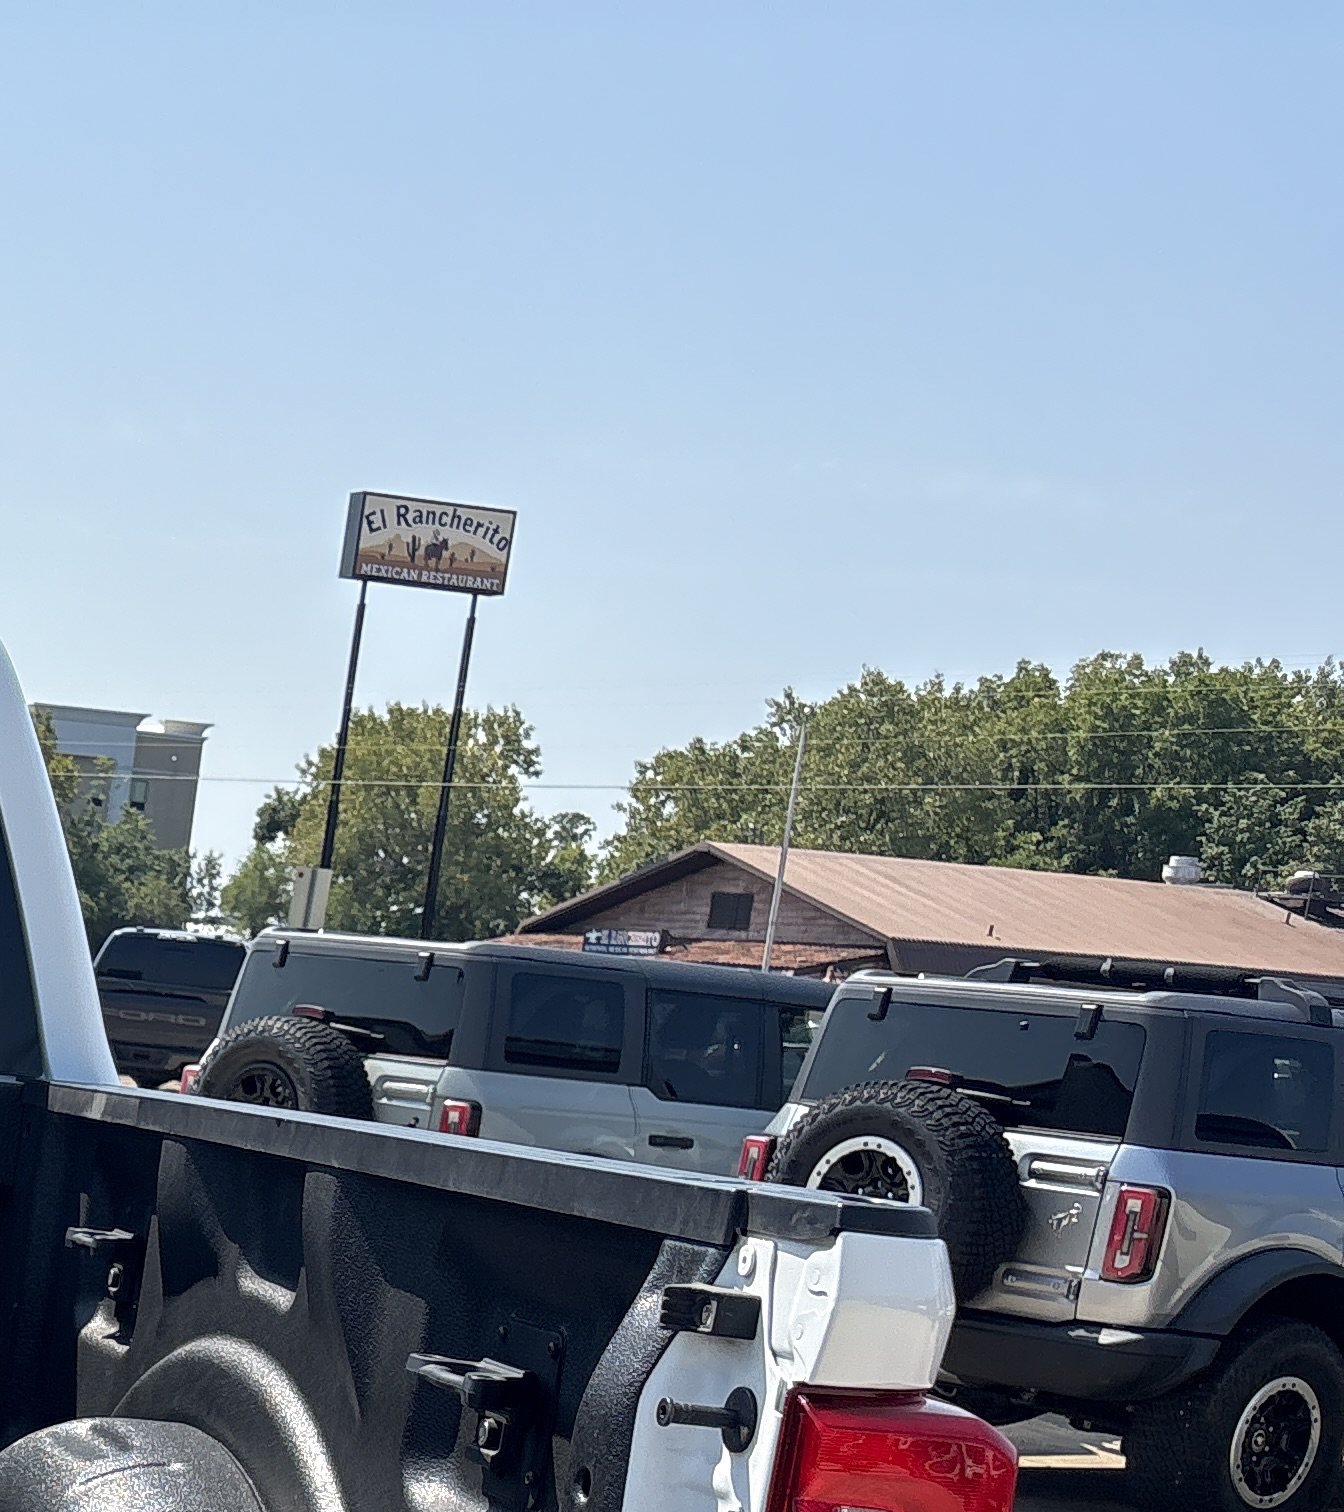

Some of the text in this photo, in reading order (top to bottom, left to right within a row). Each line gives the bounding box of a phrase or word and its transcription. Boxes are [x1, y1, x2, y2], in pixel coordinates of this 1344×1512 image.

[365, 504, 510, 552] El Rancherito
[361, 563, 501, 591] MEXICAN RESTAURANT
